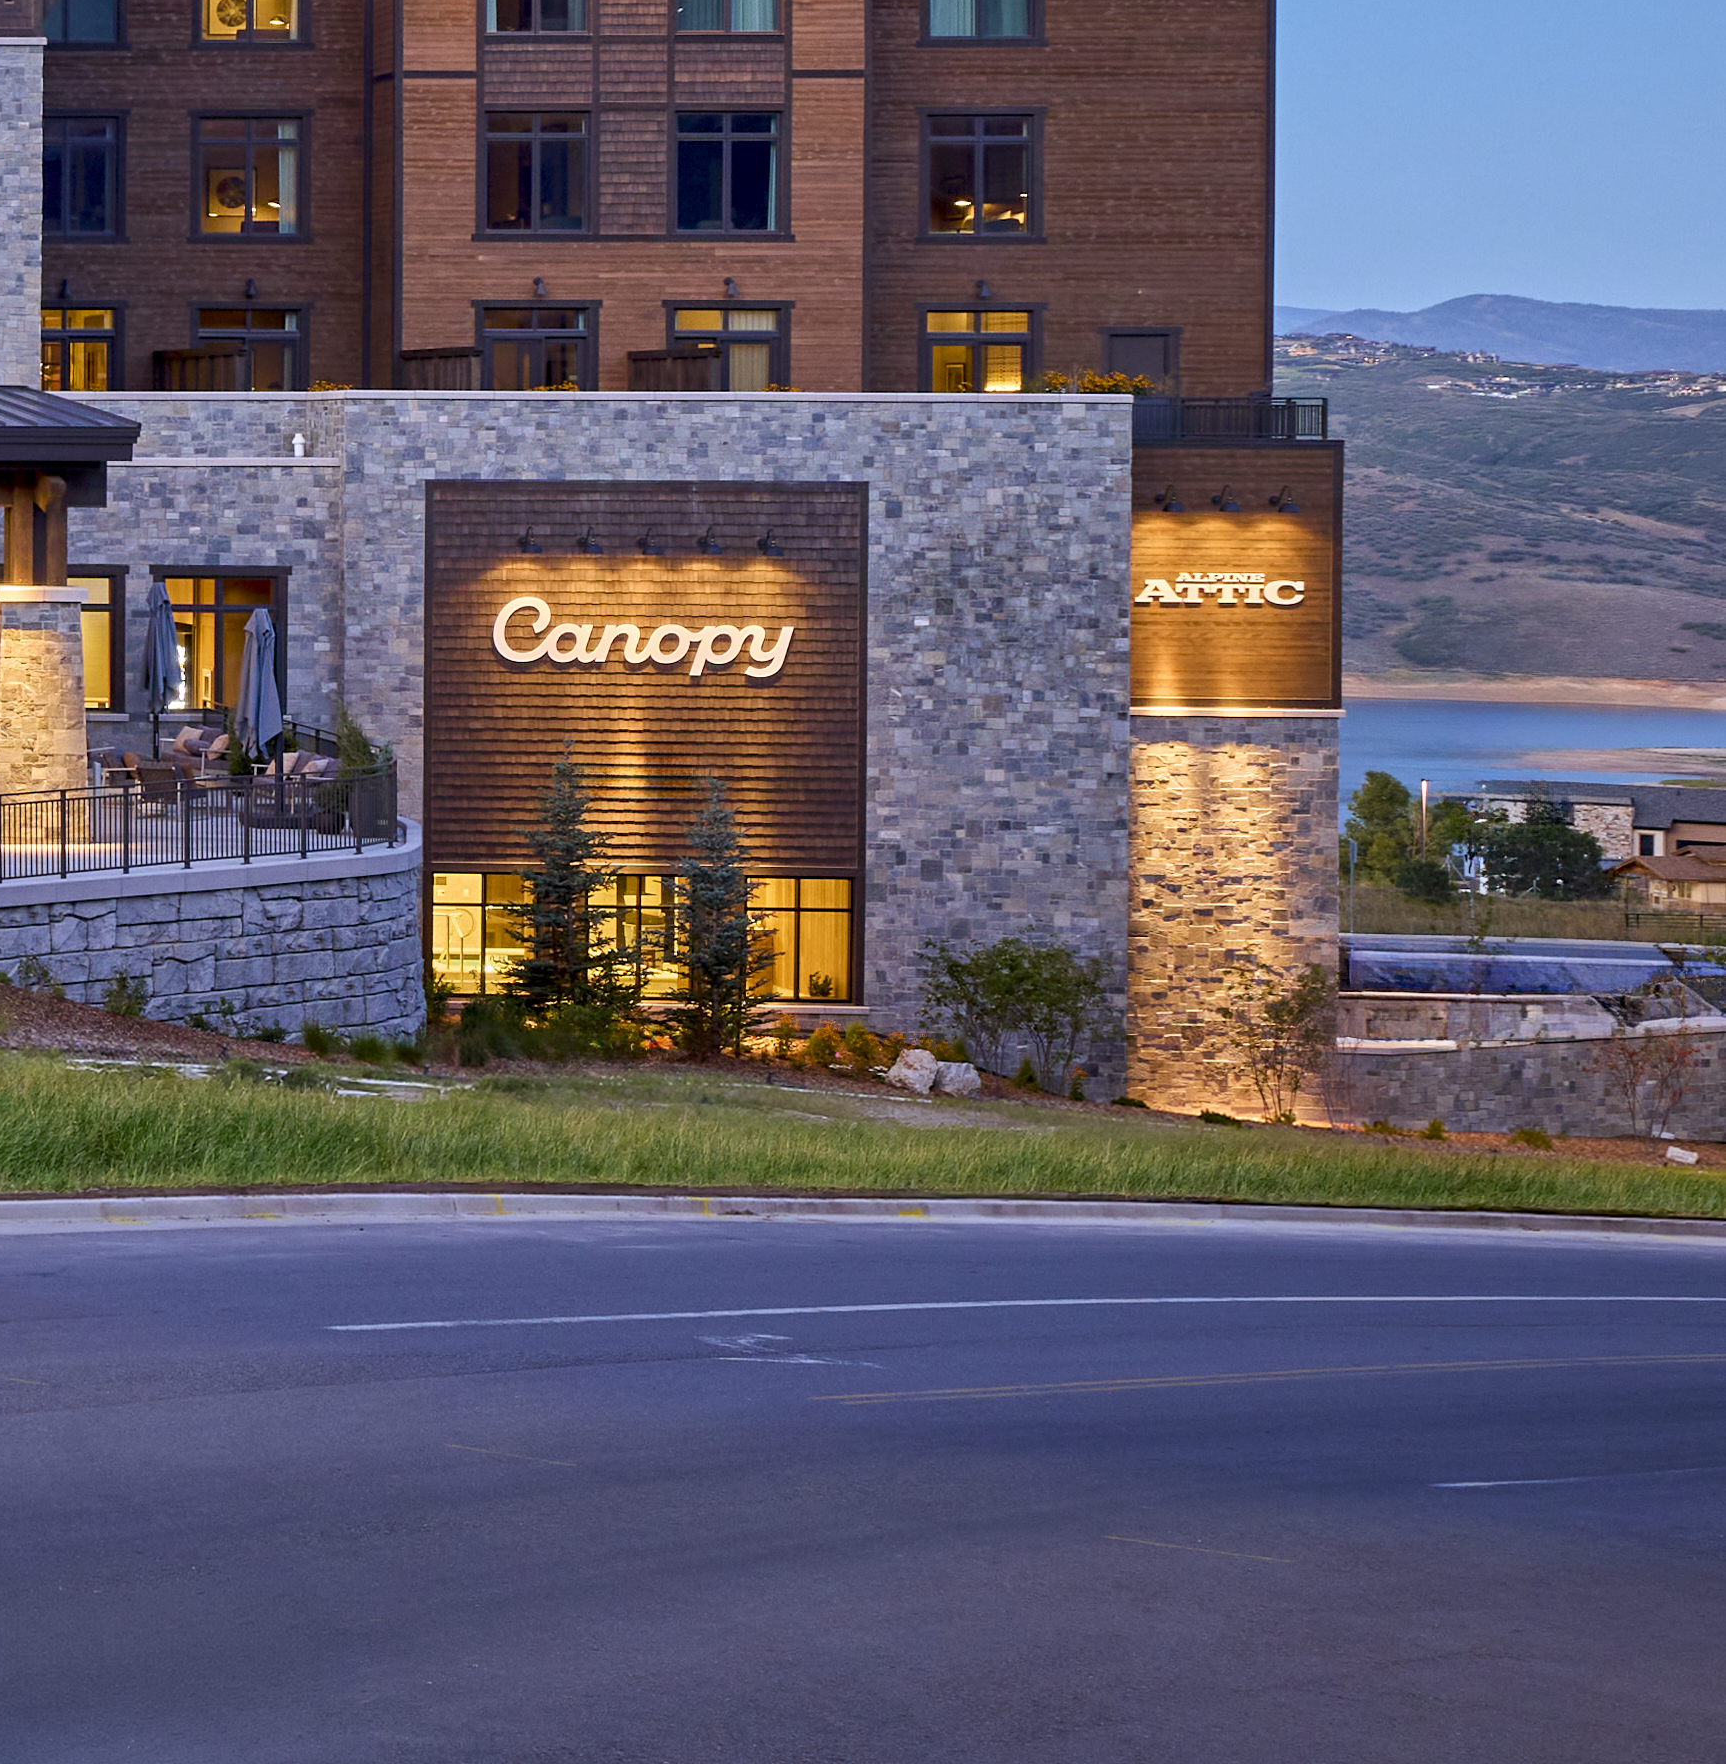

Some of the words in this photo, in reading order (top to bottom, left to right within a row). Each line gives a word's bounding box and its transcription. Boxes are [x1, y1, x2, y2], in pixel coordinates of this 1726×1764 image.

[1176, 572, 1266, 583] ALPINE
[1134, 579, 1305, 606] ATTIC
[492, 596, 795, 678] Canopy
